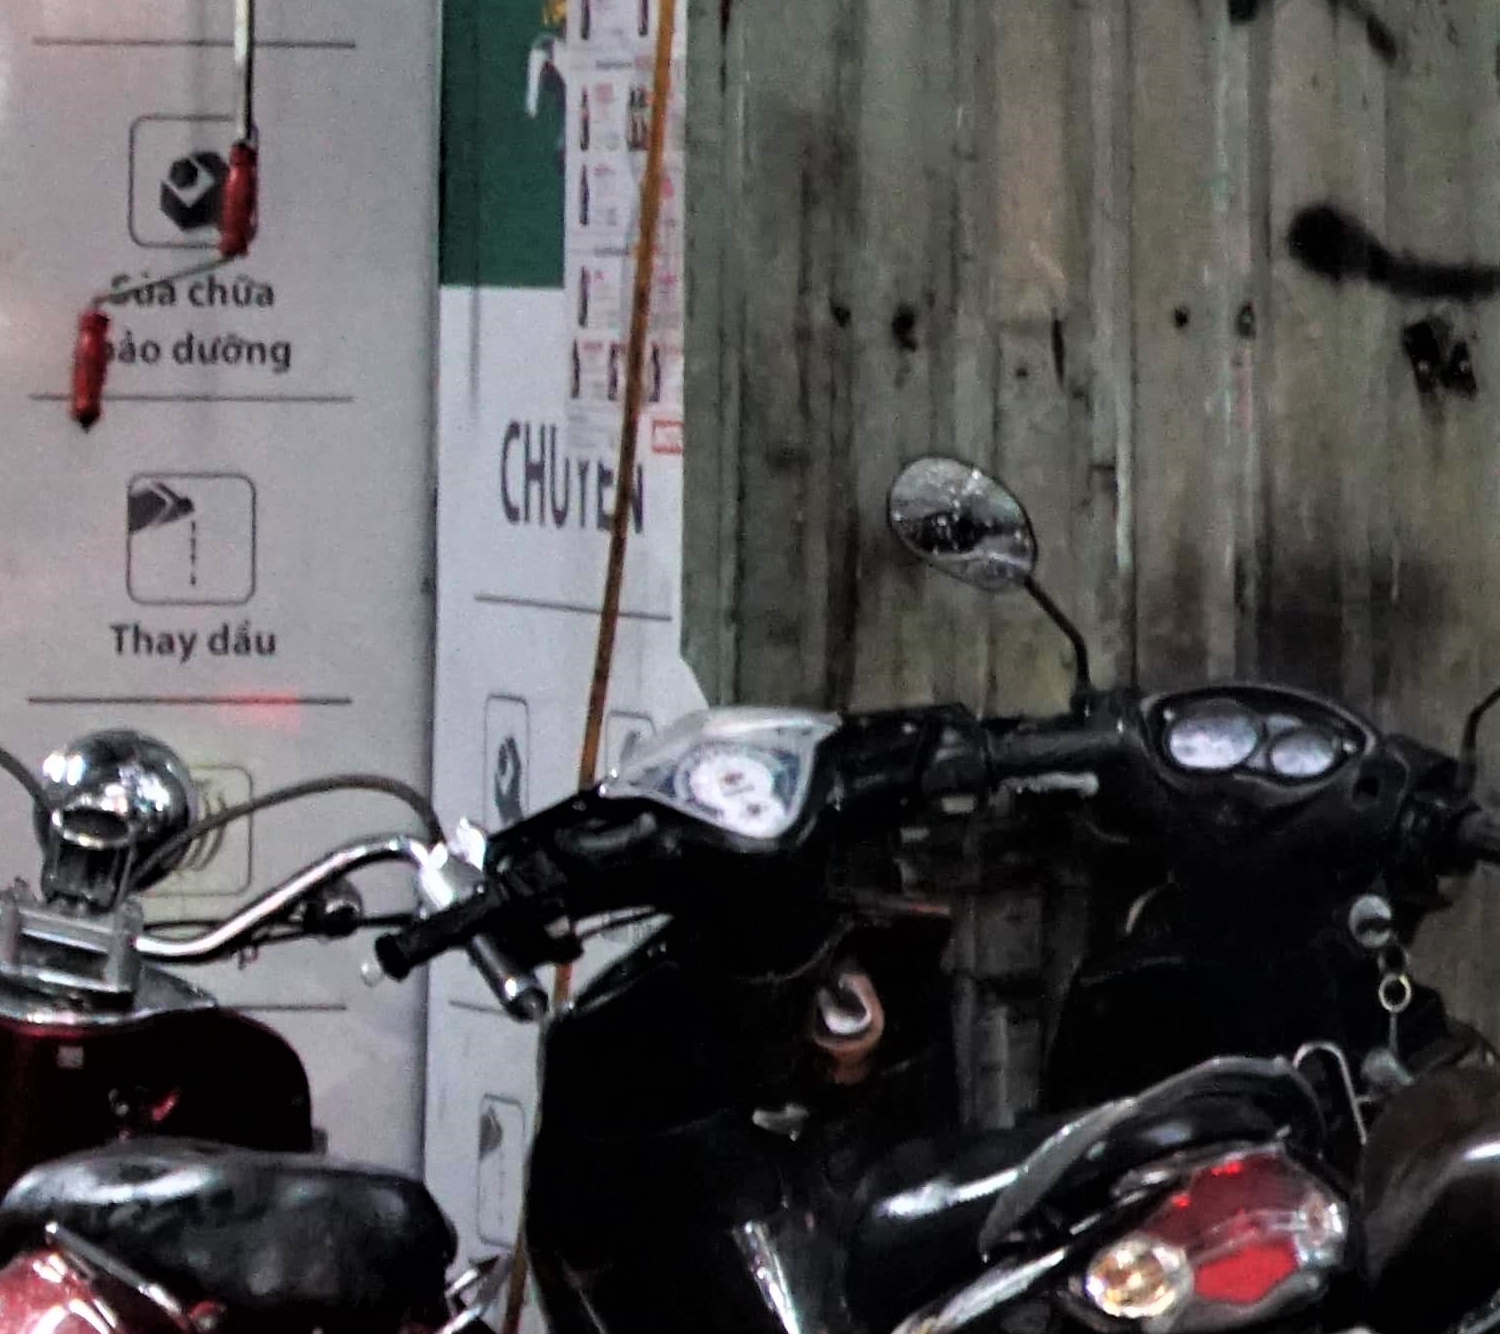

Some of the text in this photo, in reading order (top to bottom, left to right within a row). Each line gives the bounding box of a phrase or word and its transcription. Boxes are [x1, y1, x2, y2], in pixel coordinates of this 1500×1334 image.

[188, 274, 275, 308] chữa
[172, 332, 292, 374] dưỡng
[110, 624, 197, 663] Thay
